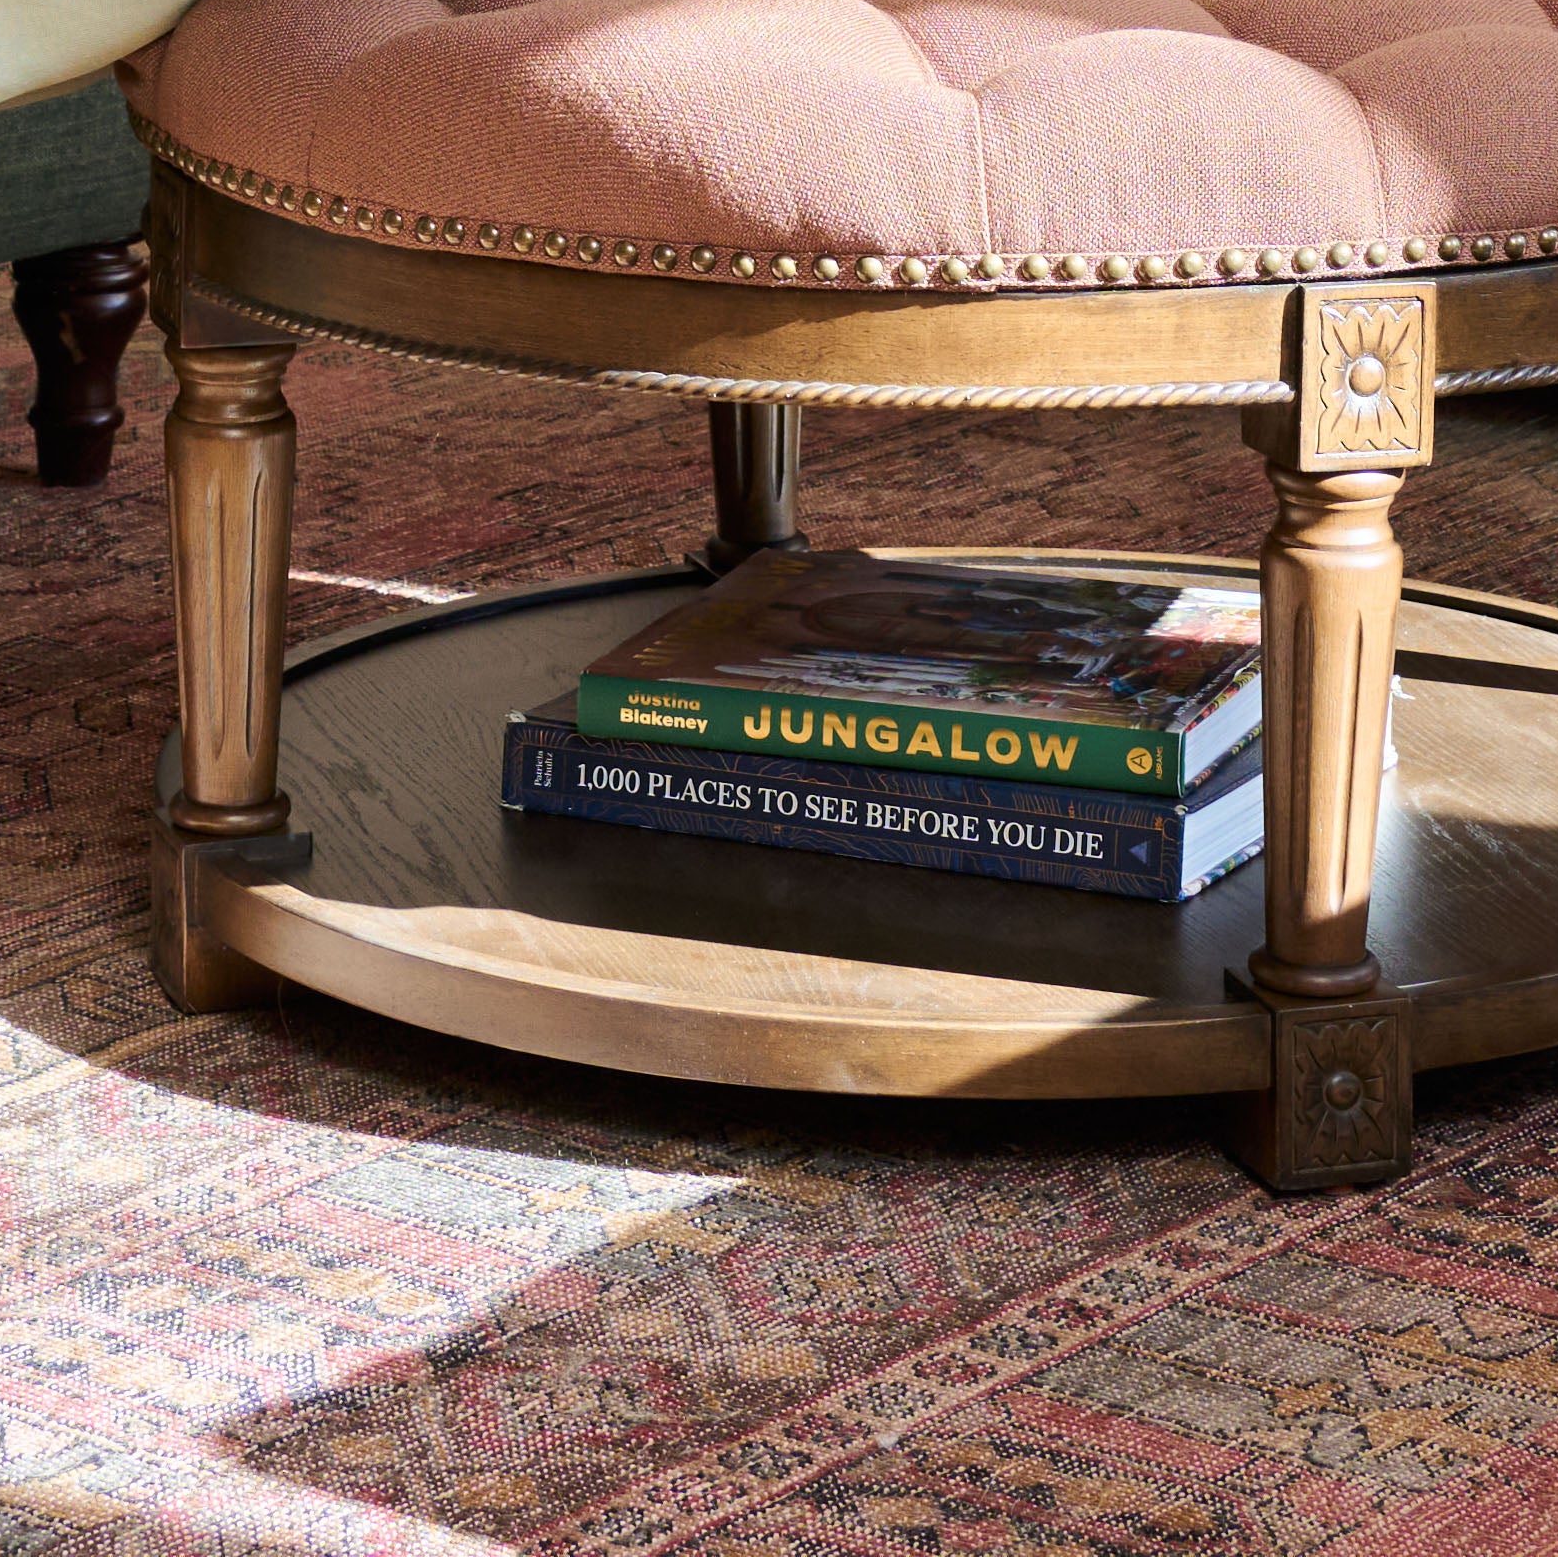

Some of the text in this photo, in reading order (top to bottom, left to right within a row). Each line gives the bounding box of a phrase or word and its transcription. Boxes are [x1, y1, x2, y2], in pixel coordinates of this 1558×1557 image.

[619, 707, 708, 734] Blakeney
[628, 690, 701, 711] Justina
[743, 704, 1079, 771] JUNGALOW
[576, 762, 1104, 859] 1,000 PLACES TO SEE BEFORE YOU DIE
